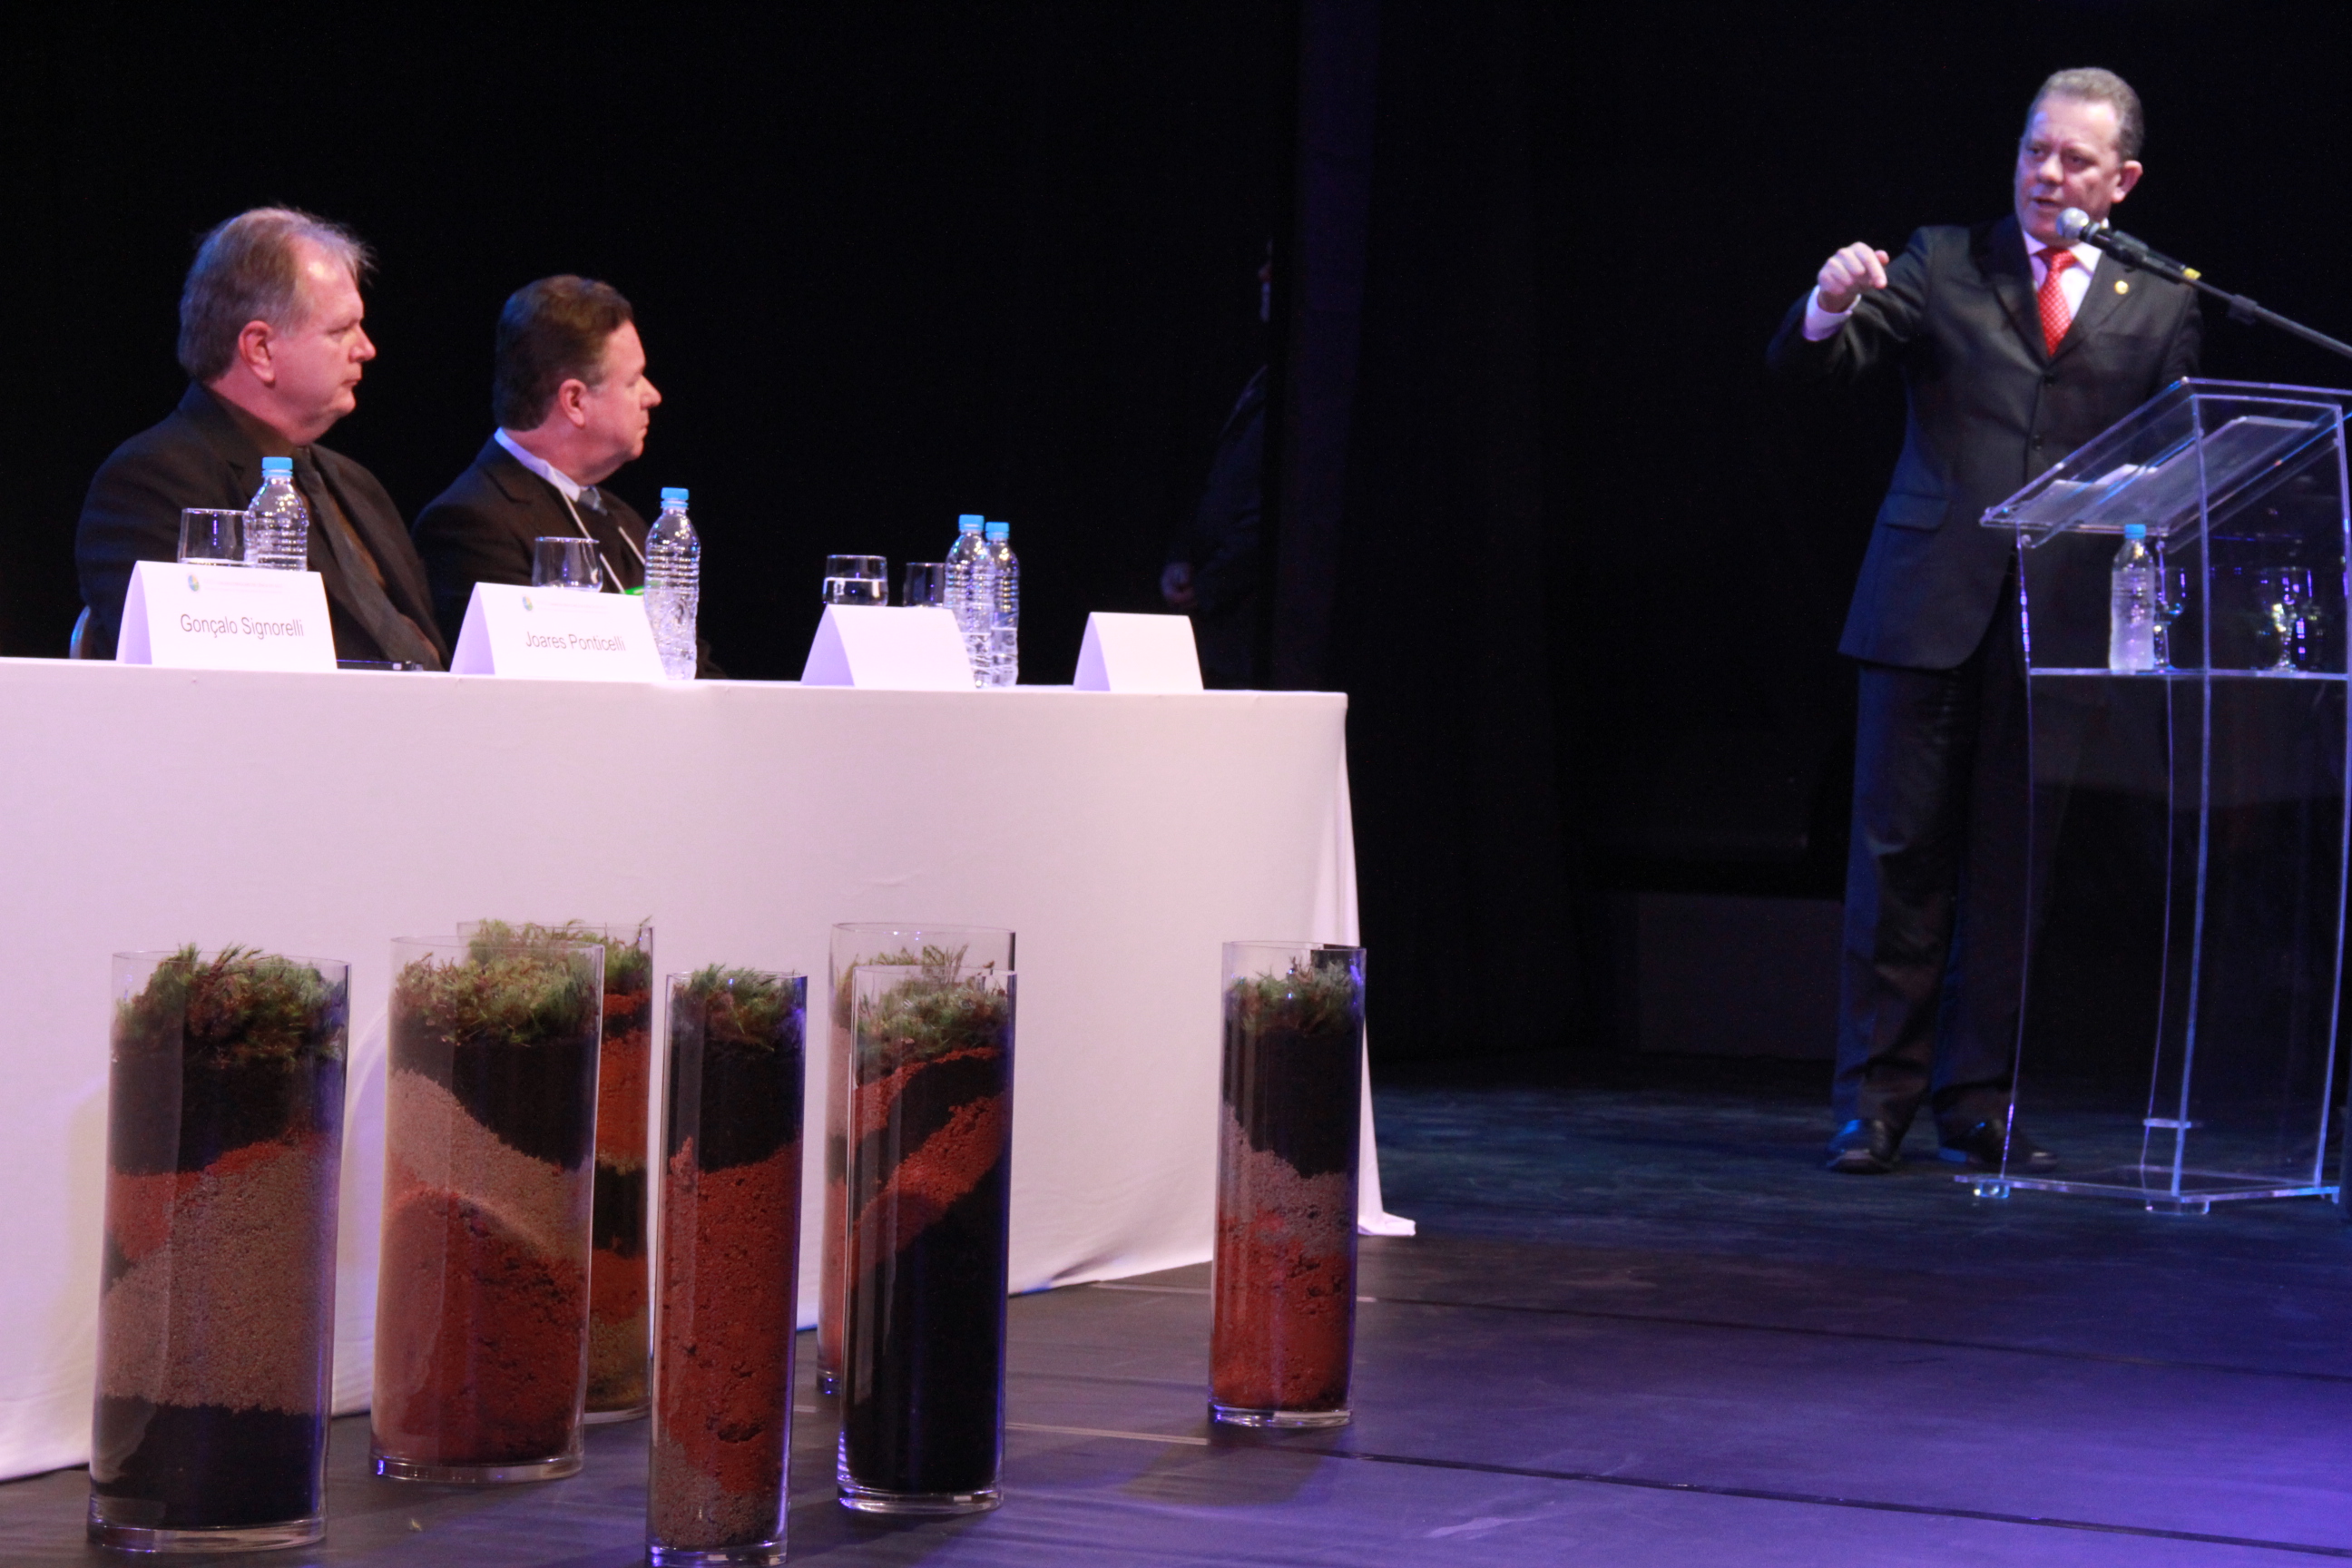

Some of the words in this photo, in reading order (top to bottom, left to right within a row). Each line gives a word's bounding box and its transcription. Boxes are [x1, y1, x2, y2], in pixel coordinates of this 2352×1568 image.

[181, 613, 238, 638] Gonçalo
[241, 617, 304, 640] Signorelli
[525, 632, 567, 649] Joares
[568, 633, 626, 652] Ponticelli
